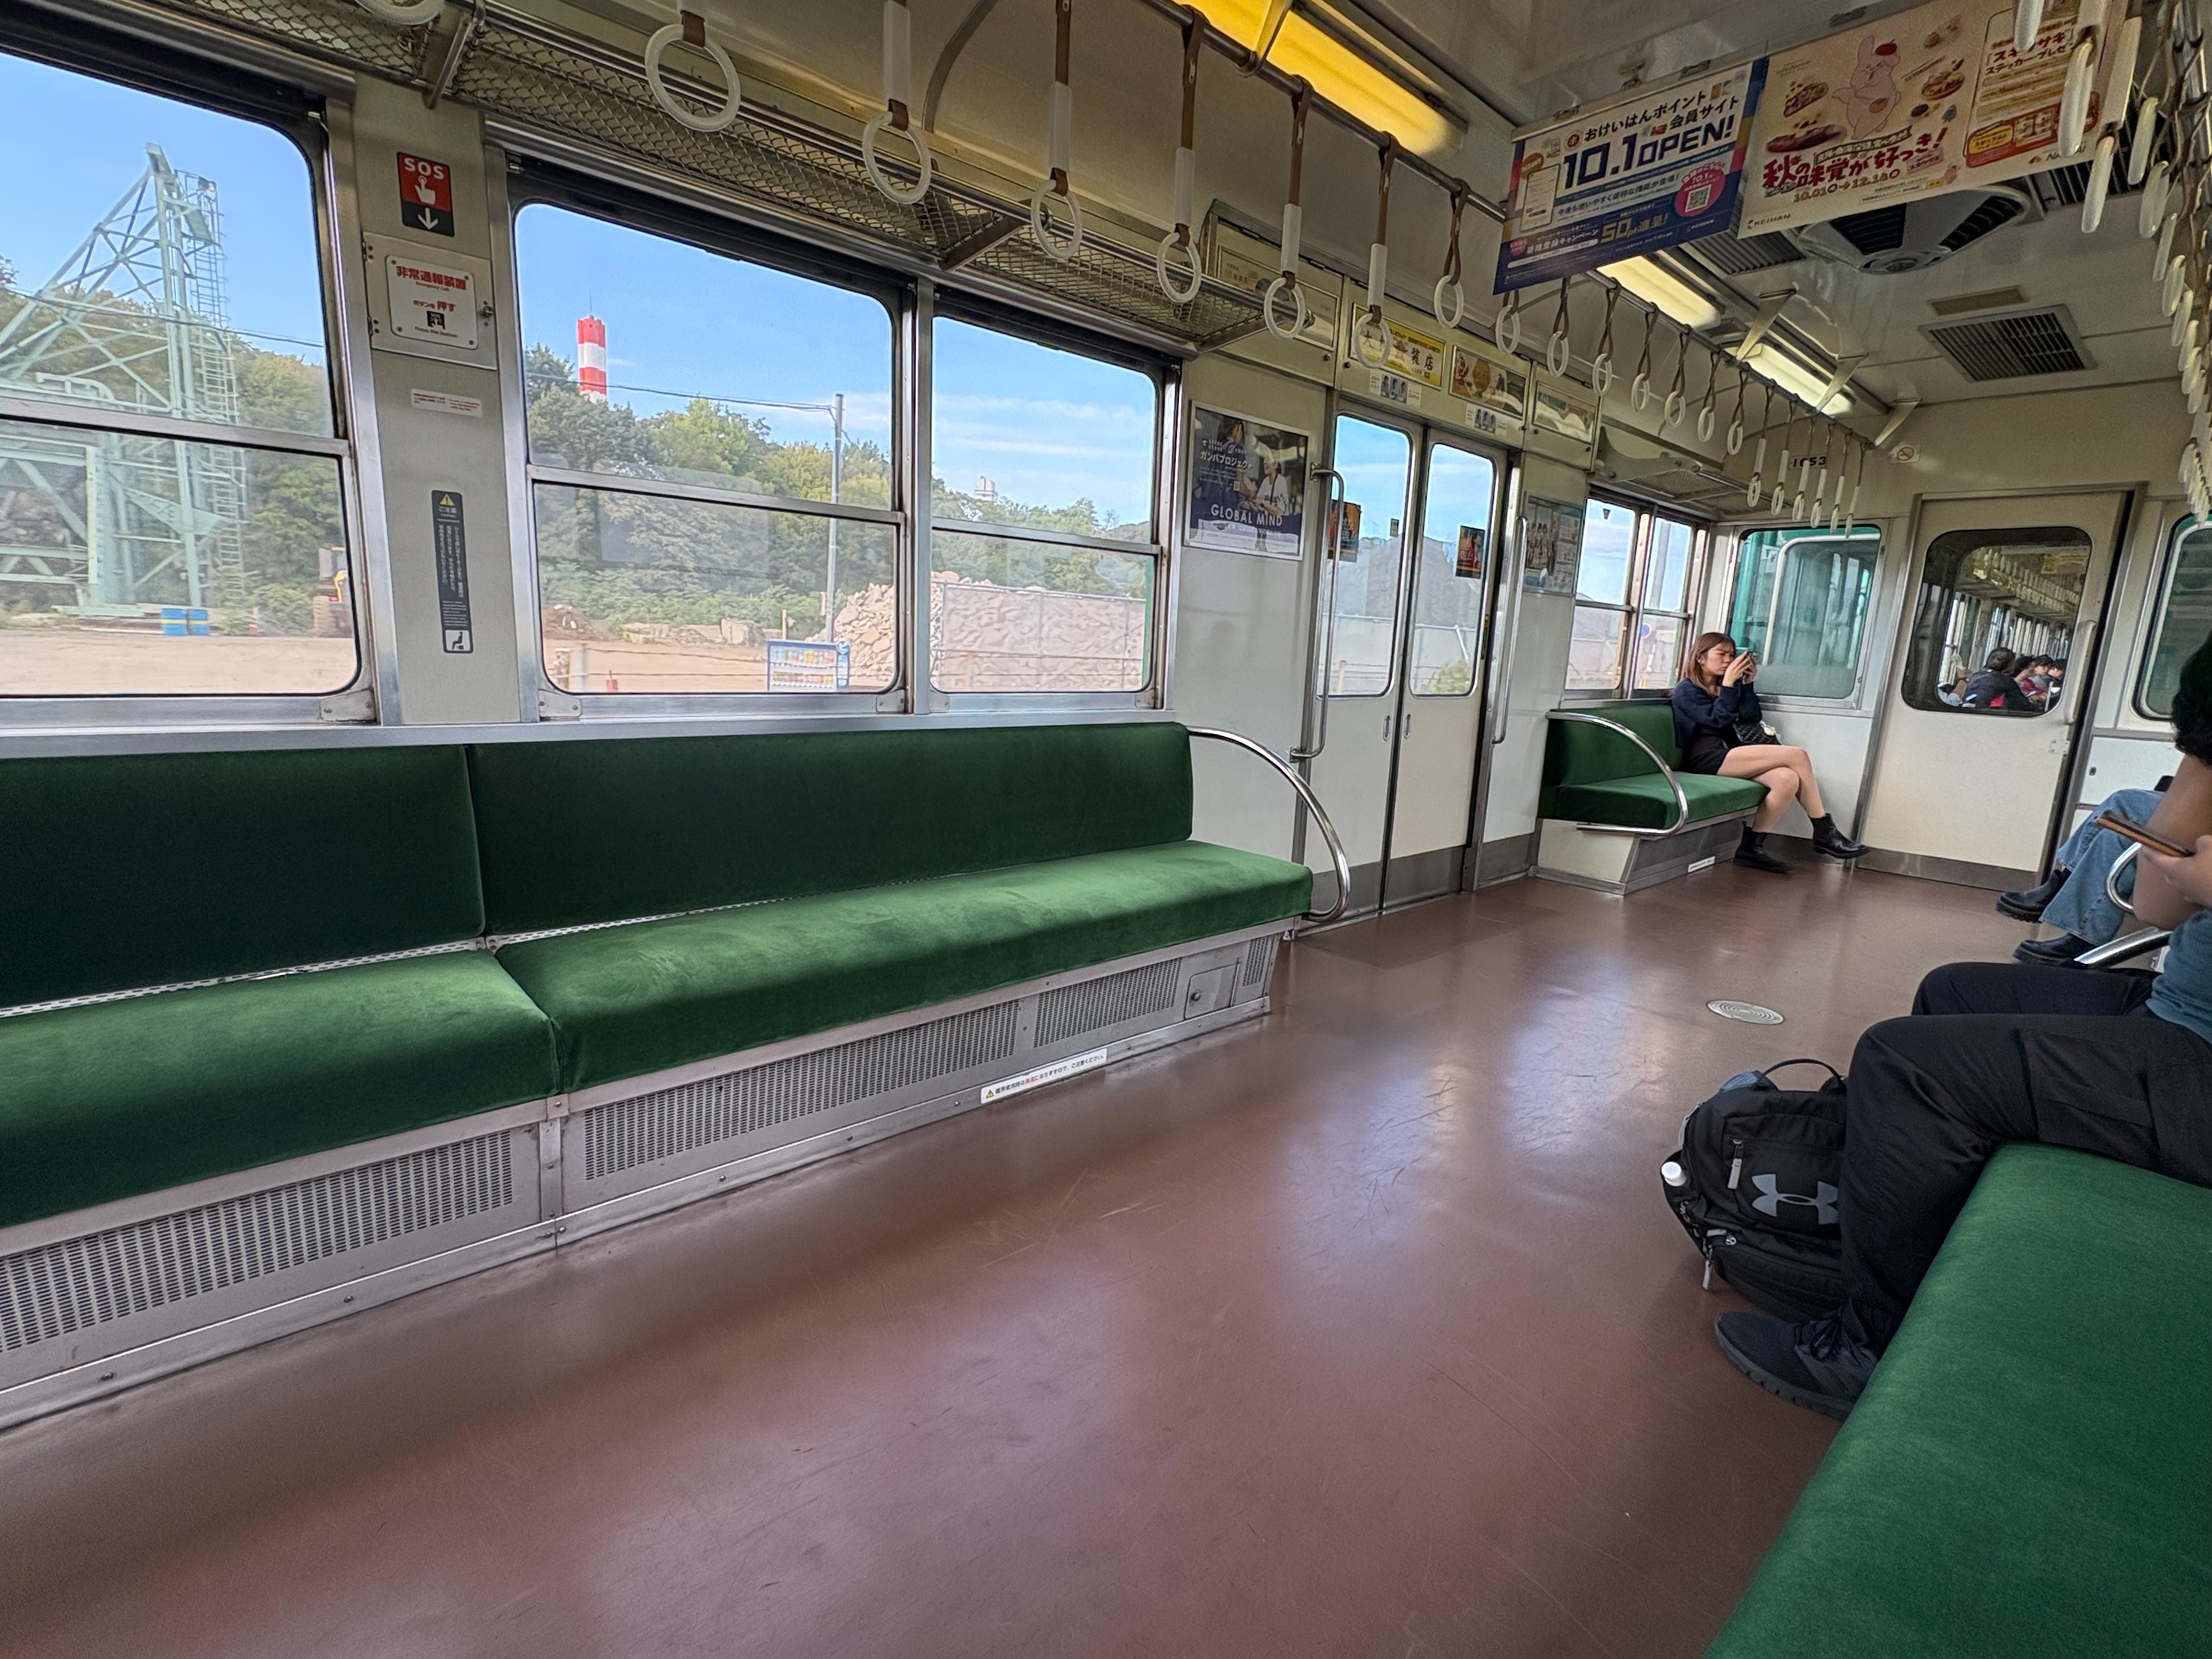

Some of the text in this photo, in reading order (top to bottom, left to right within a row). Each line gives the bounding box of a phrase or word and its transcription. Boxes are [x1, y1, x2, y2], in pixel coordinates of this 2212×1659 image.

[1584, 91, 1706, 142] おけいはんポイント
[1669, 95, 1739, 130] 会員サイト
[2046, 145, 2086, 161] NAAI
[404, 157, 444, 180] SOS
[1754, 213, 1791, 227] KEIHAN
[396, 266, 467, 291] 非常通報装置
[1200, 451, 1252, 469] ガンバプロジェクト
[1211, 504, 1283, 527] GLOBAL MIND
